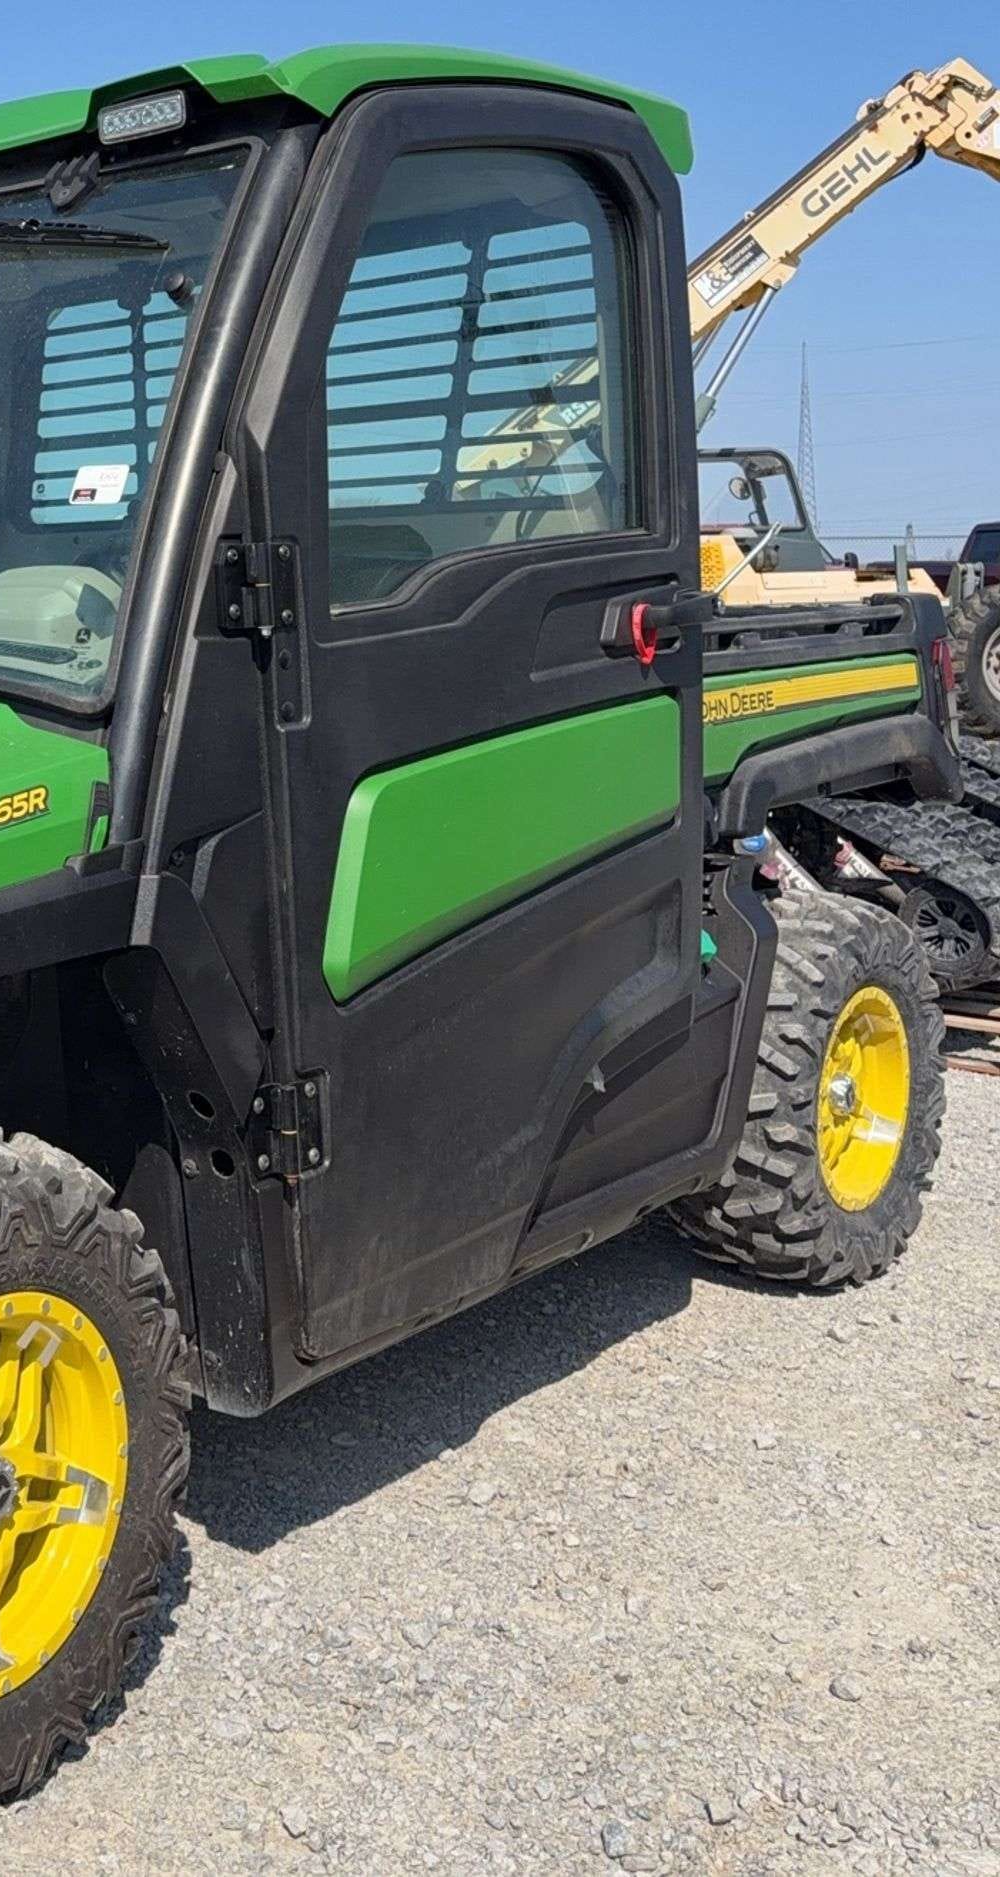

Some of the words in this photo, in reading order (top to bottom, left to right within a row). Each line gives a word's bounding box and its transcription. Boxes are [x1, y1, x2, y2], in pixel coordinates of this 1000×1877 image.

[801, 147, 892, 218] GEHL
[702, 697, 729, 719] OHN
[730, 690, 775, 714] DEERE
